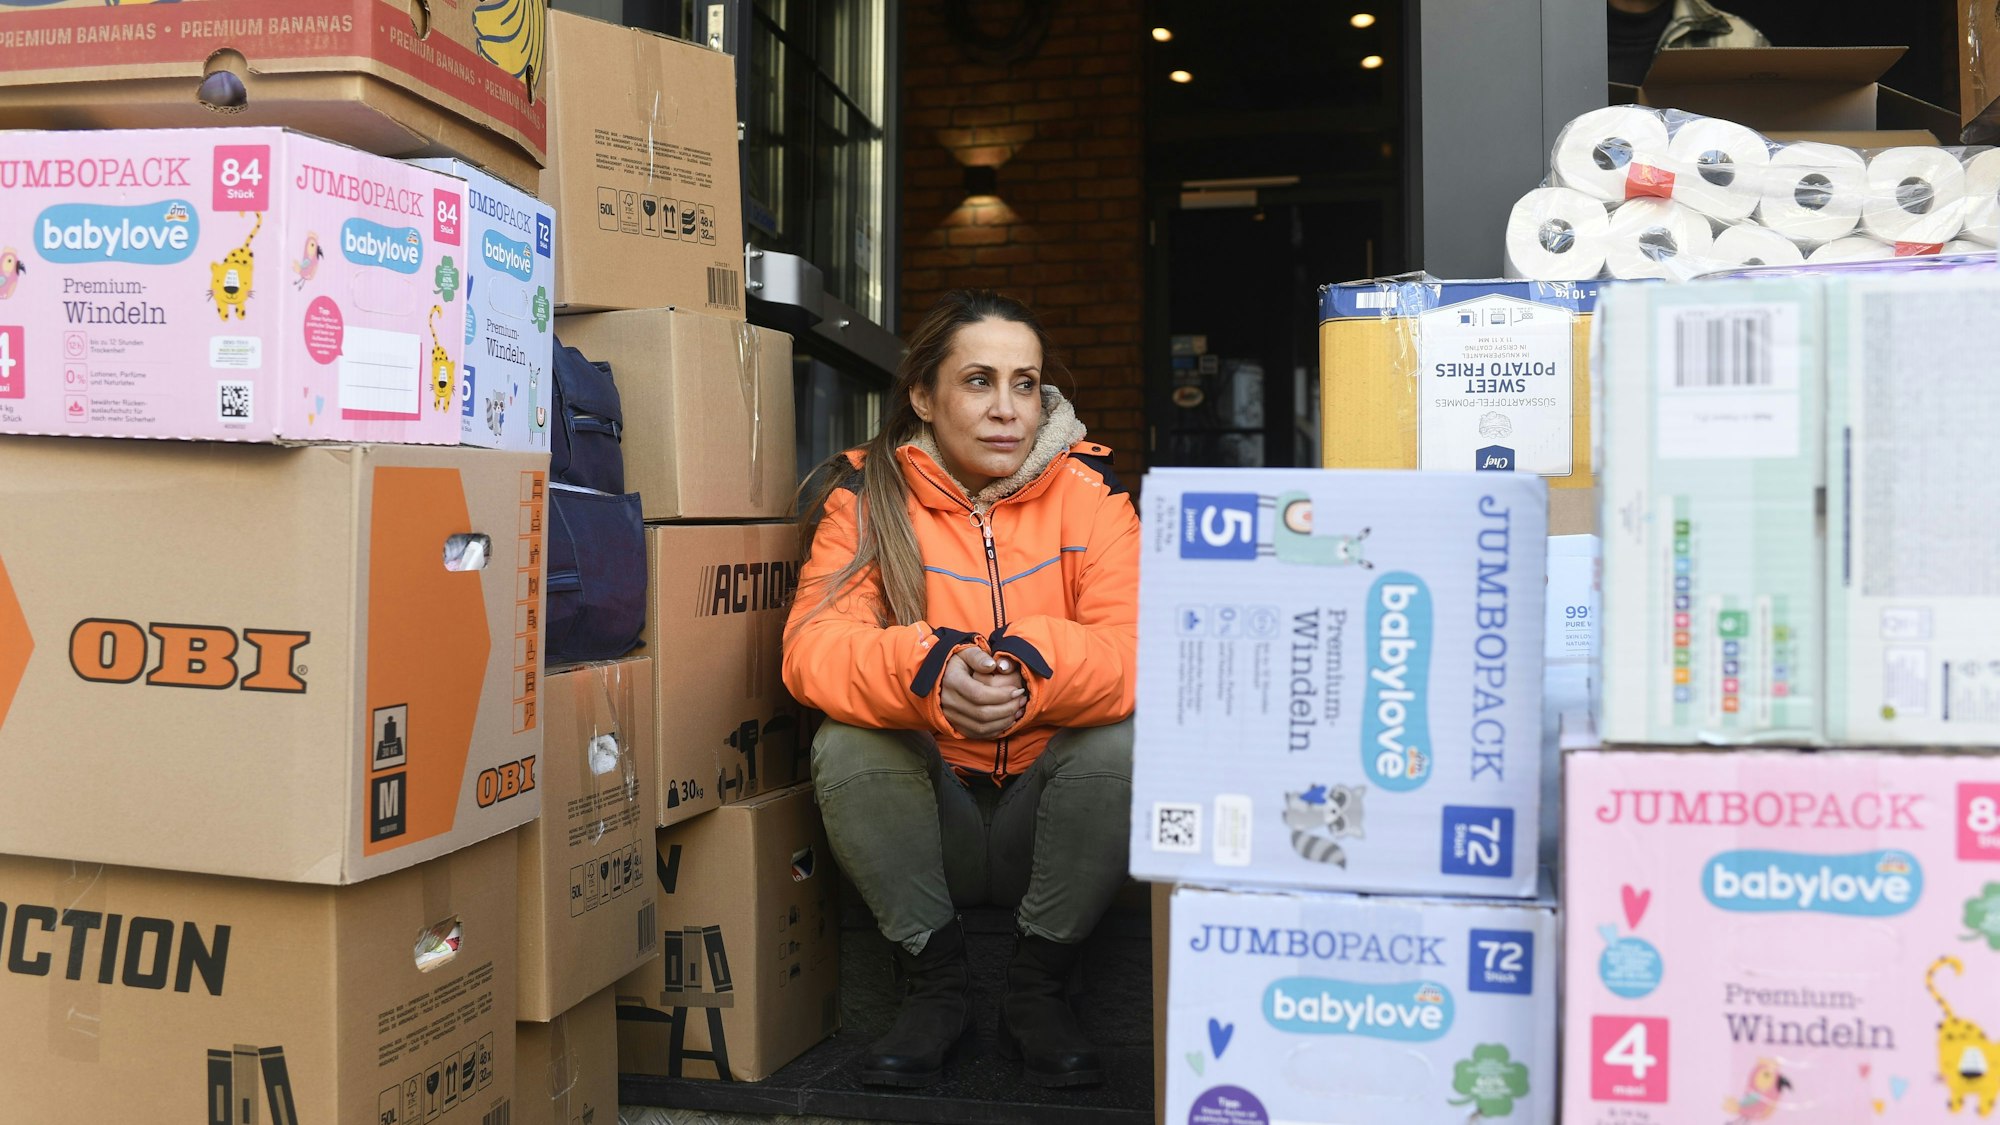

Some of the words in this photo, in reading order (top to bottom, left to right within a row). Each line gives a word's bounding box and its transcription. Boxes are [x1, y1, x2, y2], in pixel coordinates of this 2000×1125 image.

[0, 28, 71, 48] PREMIUM
[77, 23, 156, 44] BANANAS
[181, 18, 261, 38] PREMIUM
[268, 15, 353, 35] BANANAS
[390, 27, 435, 65] PREMIUM
[436, 51, 475, 87] BANANAS
[485, 78, 520, 110] PREMIUM
[0, 158, 190, 189] UMBOPACK
[221, 158, 262, 186] 84
[227, 189, 255, 200] Stück
[296, 165, 424, 218] JUMBOPACK
[437, 200, 458, 225] 84
[469, 189, 532, 234] UMBOPACK
[600, 203, 615, 216] 50L
[700, 217, 708, 227] 48
[43, 219, 189, 258] babylove
[345, 227, 419, 266] babylove
[539, 222, 550, 243] 72
[485, 239, 531, 274] babylove
[63, 278, 147, 296] Premium-
[1572, 290, 1586, 300] 10
[63, 301, 166, 325] Windeln
[486, 318, 520, 341] Premium-
[486, 337, 526, 366] Windeln
[1435, 362, 1485, 378] FRIES
[1465, 379, 1526, 393] SWEET
[1491, 362, 1556, 377] POTATO
[1435, 397, 1556, 409] SÜSSKARTOFFEL-POMMES
[1482, 454, 1509, 469] Chef
[1184, 508, 1200, 544] junior
[1201, 505, 1252, 546] 5
[712, 561, 799, 616] ACTION
[1566, 606, 1591, 619] 99
[1471, 495, 1511, 781] JUMBOPACK
[1289, 608, 1320, 754] Windeln
[1324, 609, 1347, 728] Premium-
[1371, 584, 1418, 779] babylove
[379, 779, 399, 820] M
[476, 755, 536, 809] OBI
[1596, 789, 1927, 831] JUMBOPACK
[1965, 796, 2000, 833] 8
[1453, 822, 1470, 859] Stück
[1467, 817, 1500, 867] 72
[572, 883, 582, 899] 50L
[1713, 863, 1912, 908] babylove
[0, 901, 231, 997] CTION
[1189, 924, 1447, 966] JUMBOPACK
[1478, 941, 1524, 972] 72
[1273, 988, 1443, 1032] babylove
[1723, 983, 1862, 1010] Premium-
[1725, 1012, 1895, 1049] Windeln
[480, 1051, 487, 1065] 48
[1603, 1022, 1658, 1080] 4
[381, 1108, 398, 1125] 50L
